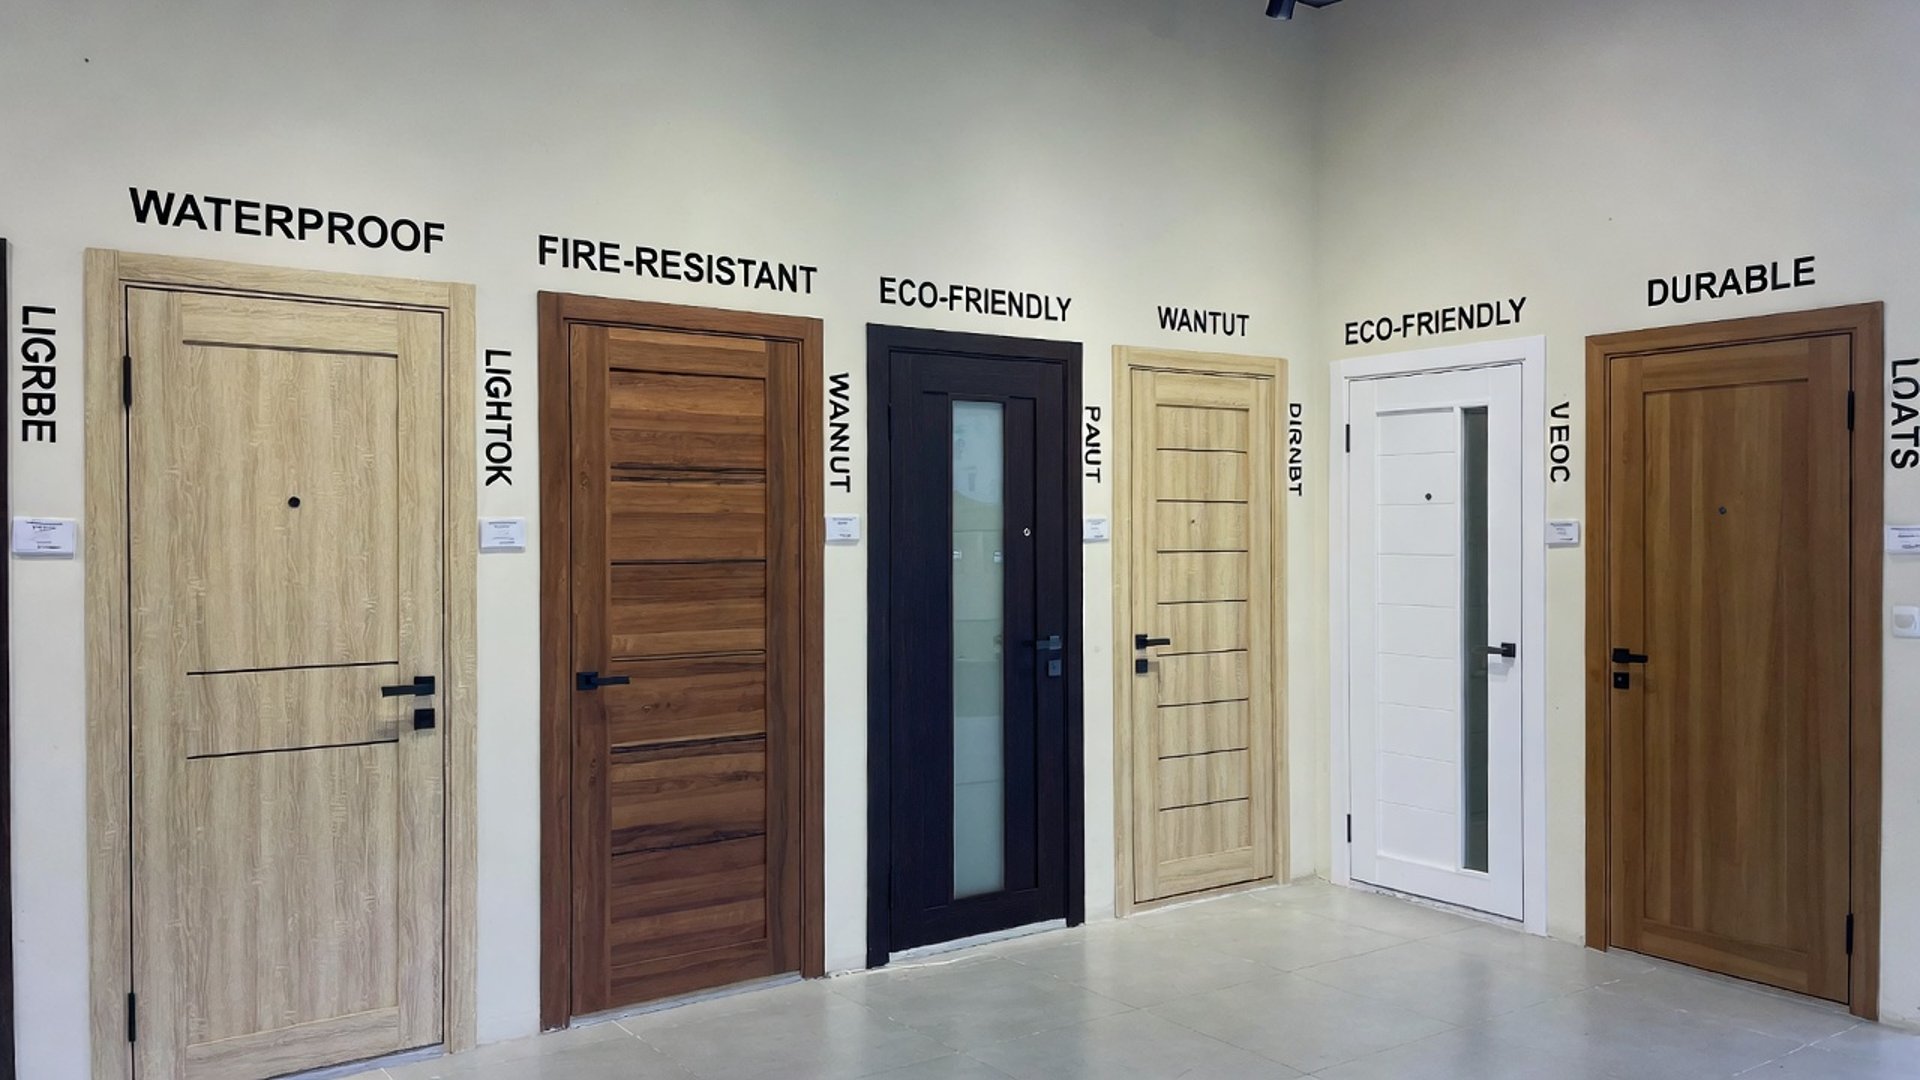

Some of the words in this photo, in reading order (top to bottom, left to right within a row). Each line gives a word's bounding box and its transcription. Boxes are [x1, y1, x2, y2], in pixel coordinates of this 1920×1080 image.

[129, 187, 444, 253] WATERPROOF
[538, 234, 817, 294] FIRE-RESISTANT
[1646, 256, 1815, 307] DURABLE
[879, 277, 1072, 322] ECO-FRIENDLY
[1157, 305, 1250, 337] WANTUT
[1345, 297, 1527, 345] ECO-FRIENDLY
[21, 305, 57, 444] LIGRBE
[484, 349, 513, 487] LIGHTOK
[1890, 358, 1920, 469] LOATS
